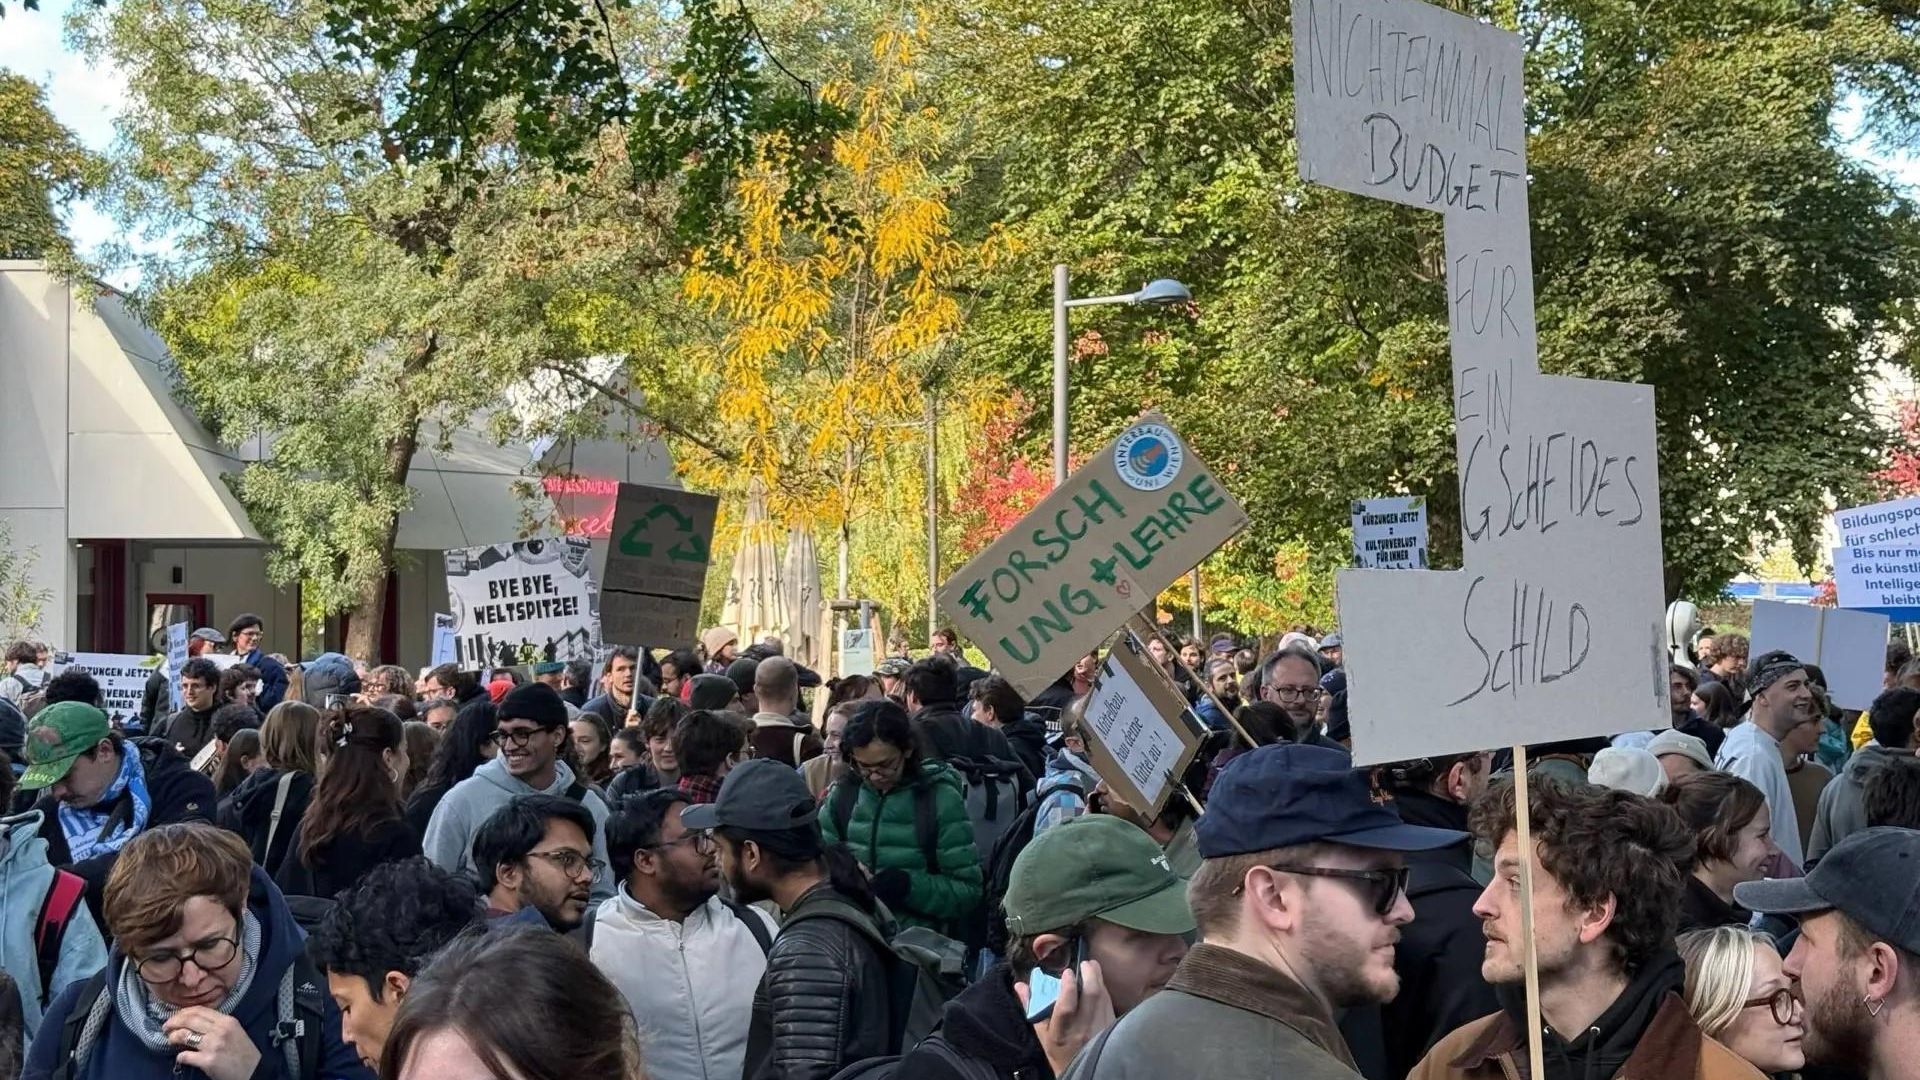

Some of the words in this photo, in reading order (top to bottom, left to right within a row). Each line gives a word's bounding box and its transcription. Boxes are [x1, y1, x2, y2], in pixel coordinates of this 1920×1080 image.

[1361, 112, 1520, 213] BUDGET
[1454, 249, 1519, 337] FÜR
[1458, 358, 1513, 435] EIN
[1362, 512, 1398, 526] KÜRZUNGEN
[1399, 511, 1419, 523] JETZT
[958, 478, 1128, 623] FORSCH
[1365, 536, 1417, 551] KULTURVERLUST
[1845, 534, 1866, 547] für
[1853, 548, 1875, 558] Bis
[1879, 549, 1902, 558] nur
[1376, 550, 1388, 563] FÜR
[1390, 550, 1409, 562] IMMER
[1851, 562, 1873, 574] die
[488, 578, 519, 600] BYE
[522, 574, 559, 596] BYE,
[473, 596, 579, 625] WELTSPITZE!
[1446, 576, 1591, 708] SCHILD
[1095, 691, 1126, 740] Mittelbau,
[1121, 716, 1144, 748] deine
[1130, 751, 1155, 789] Mittel
